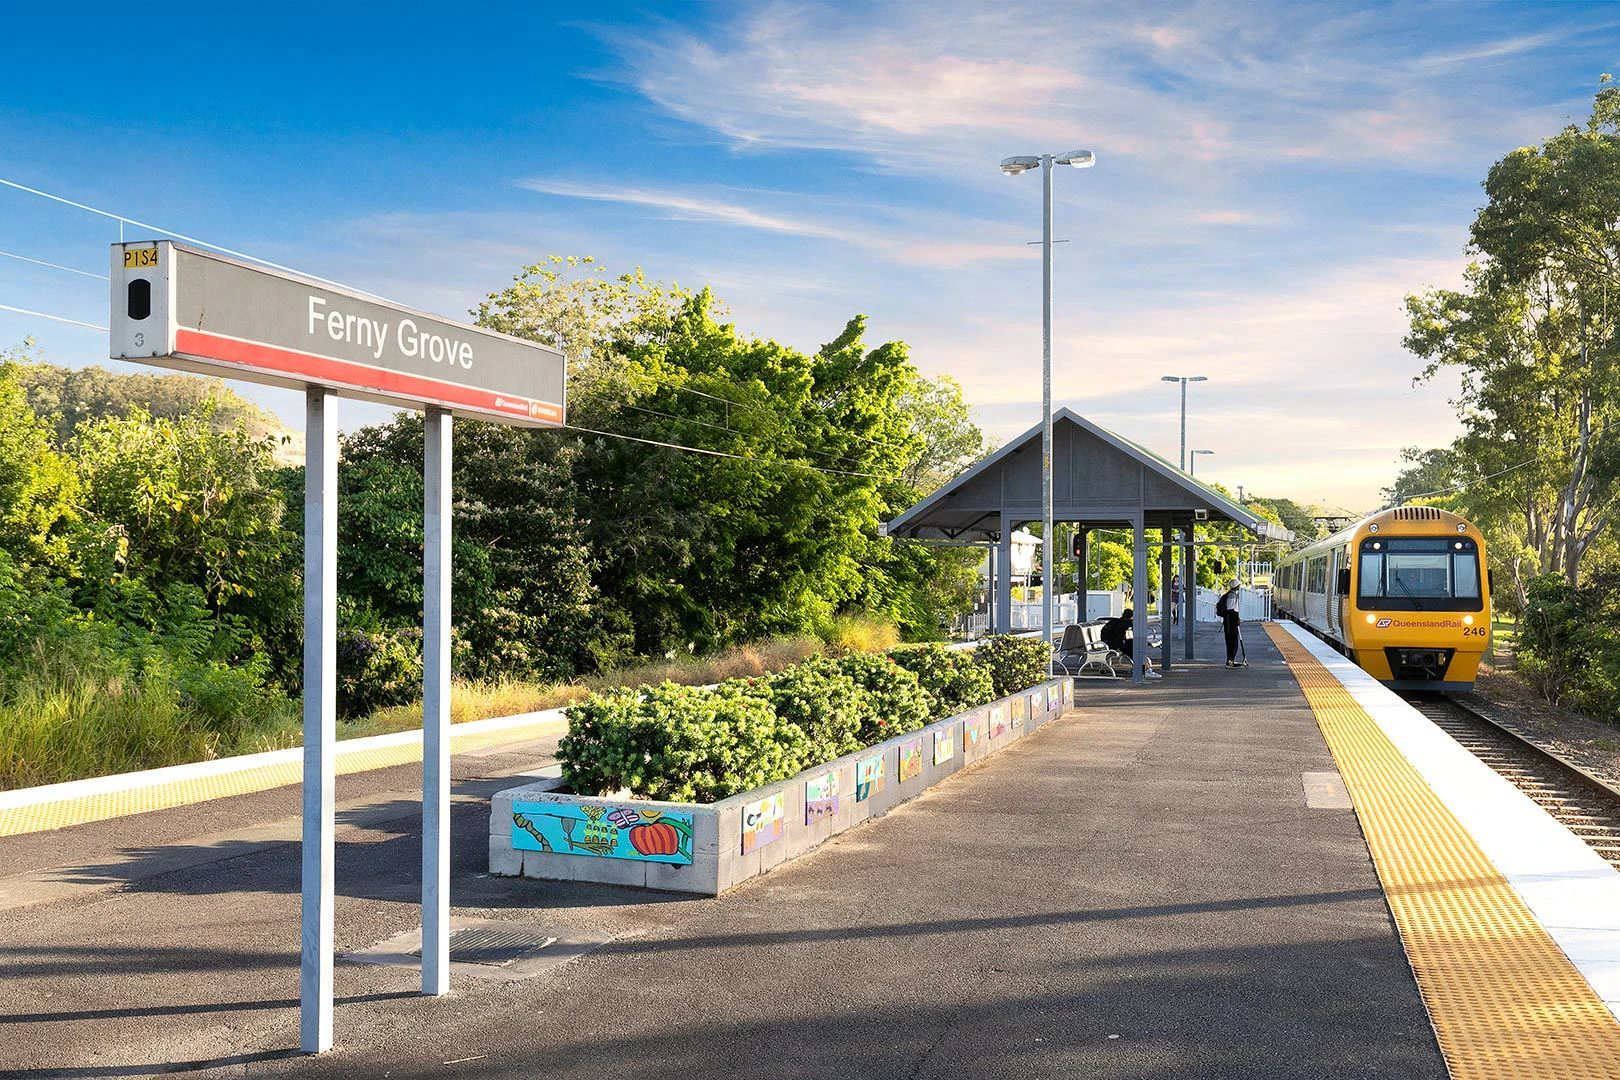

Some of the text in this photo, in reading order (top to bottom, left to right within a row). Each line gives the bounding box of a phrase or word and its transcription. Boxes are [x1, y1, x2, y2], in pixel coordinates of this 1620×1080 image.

[124, 250, 158, 267] P1S4
[134, 332, 144, 347] 3
[309, 295, 473, 370] Ferny Grove
[1393, 619, 1462, 628] QueenslandRail
[1463, 627, 1486, 636] 246
